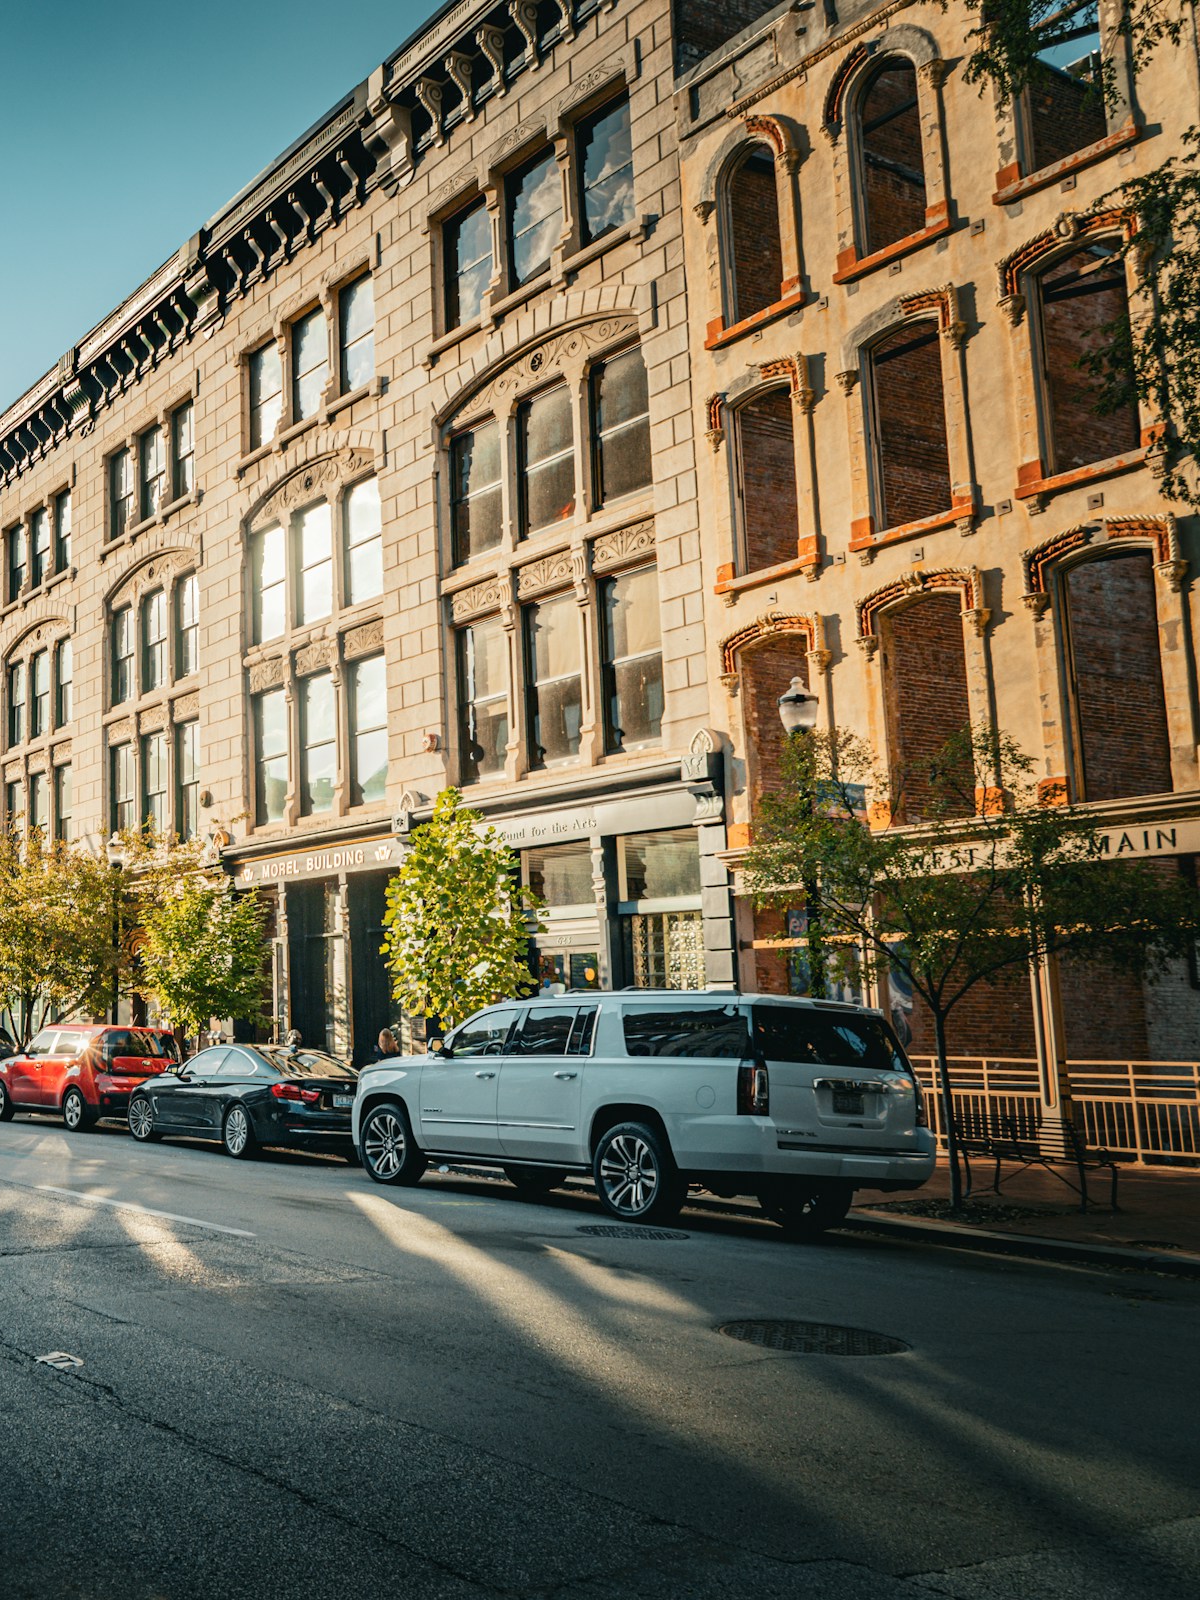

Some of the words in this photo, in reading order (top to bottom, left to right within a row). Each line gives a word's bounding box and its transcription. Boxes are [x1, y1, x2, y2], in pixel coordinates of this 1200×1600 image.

[531, 826, 547, 837] for
[552, 822, 568, 834] the
[573, 818, 597, 831] Arts
[1089, 828, 1177, 854] MAIN
[262, 859, 300, 878] MOREL
[306, 849, 365, 872] BUILDING
